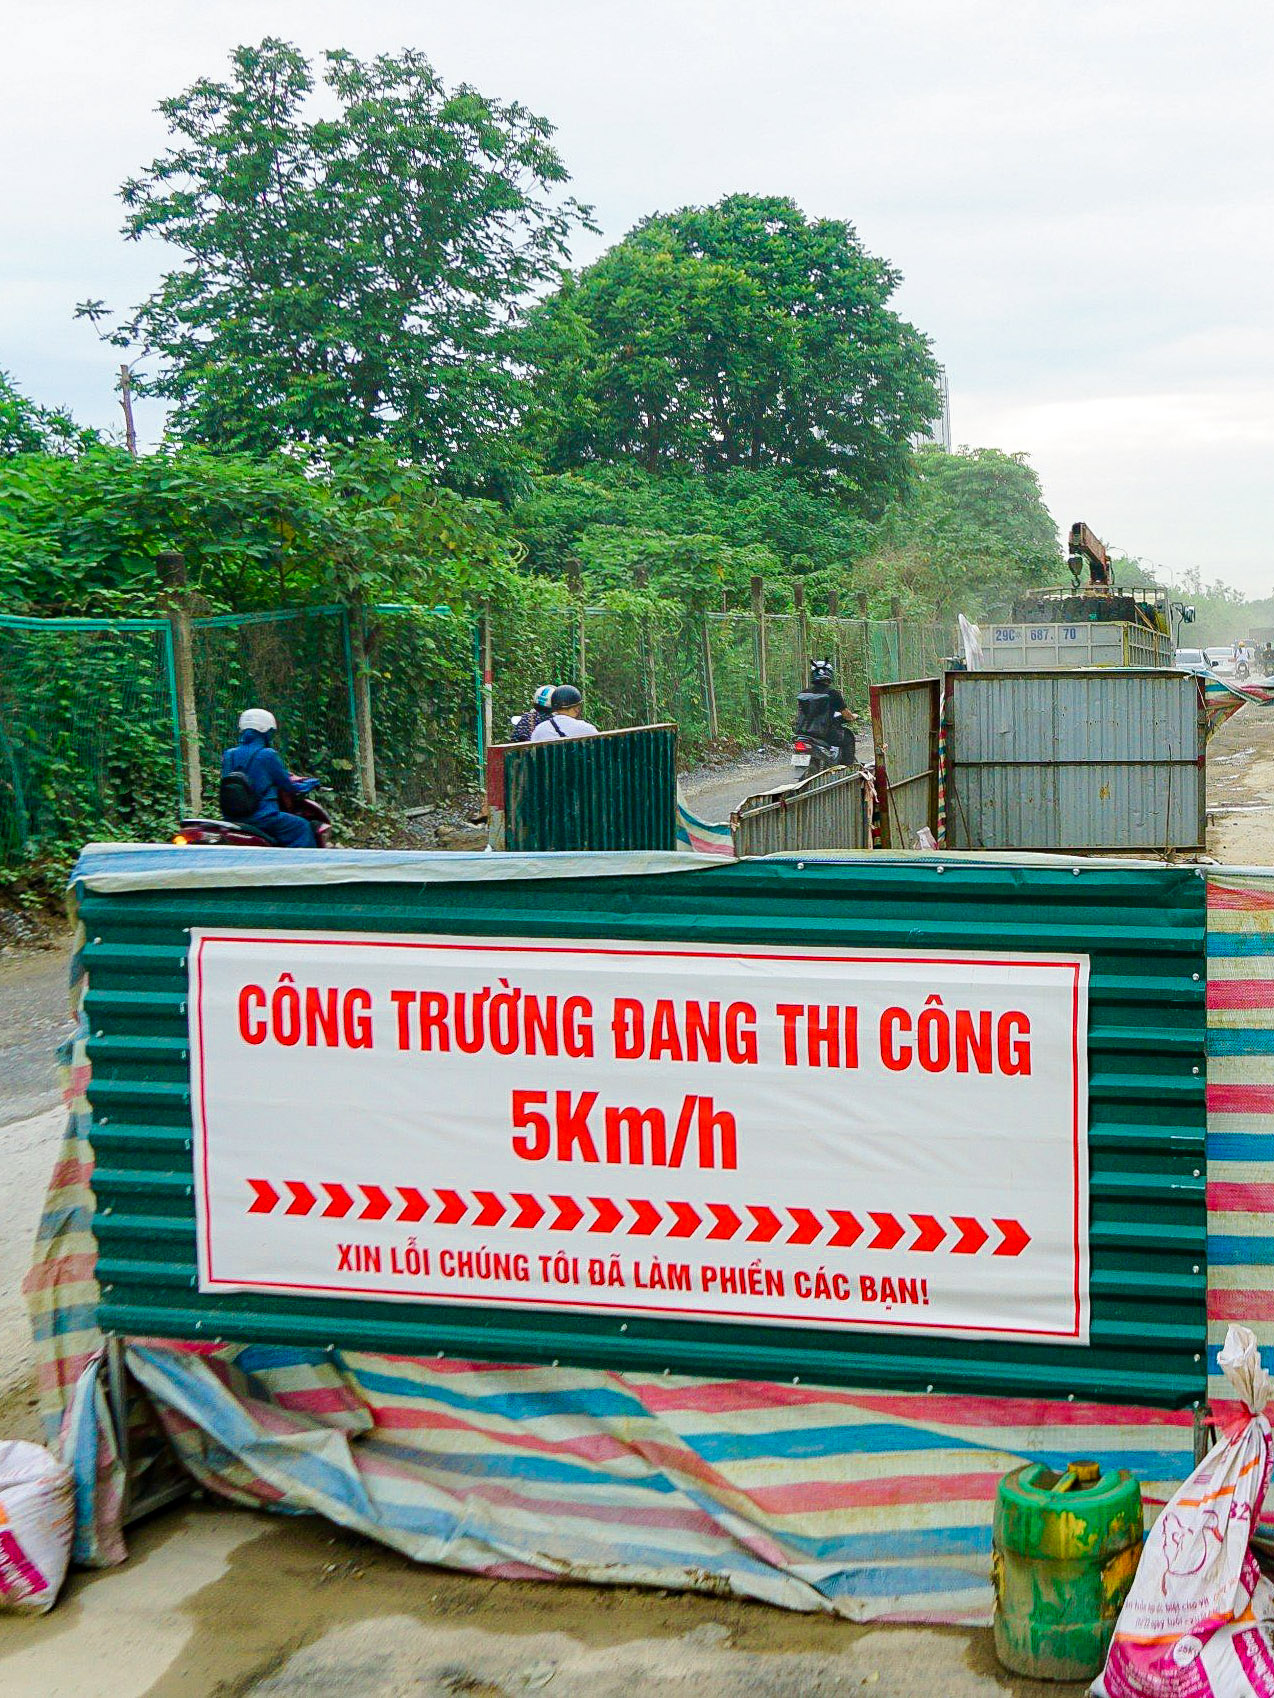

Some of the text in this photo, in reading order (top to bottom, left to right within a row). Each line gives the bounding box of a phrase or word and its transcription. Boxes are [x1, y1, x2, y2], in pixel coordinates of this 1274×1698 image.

[1063, 628, 1076, 640] 70
[238, 972, 1031, 1076] CÔNG TRƯỜNG ĐANG THI CÔNG
[512, 1089, 738, 1170] 5Km/h
[338, 1244, 381, 1273] XIN
[390, 1236, 430, 1276] LỖI
[439, 1246, 530, 1283] CHÚNG
[538, 1250, 580, 1285] TÔI
[588, 1253, 626, 1288] ĐÃ
[634, 1256, 692, 1292] LÀM
[794, 1265, 850, 1301] CÁC
[859, 1275, 930, 1310] BẠN!
